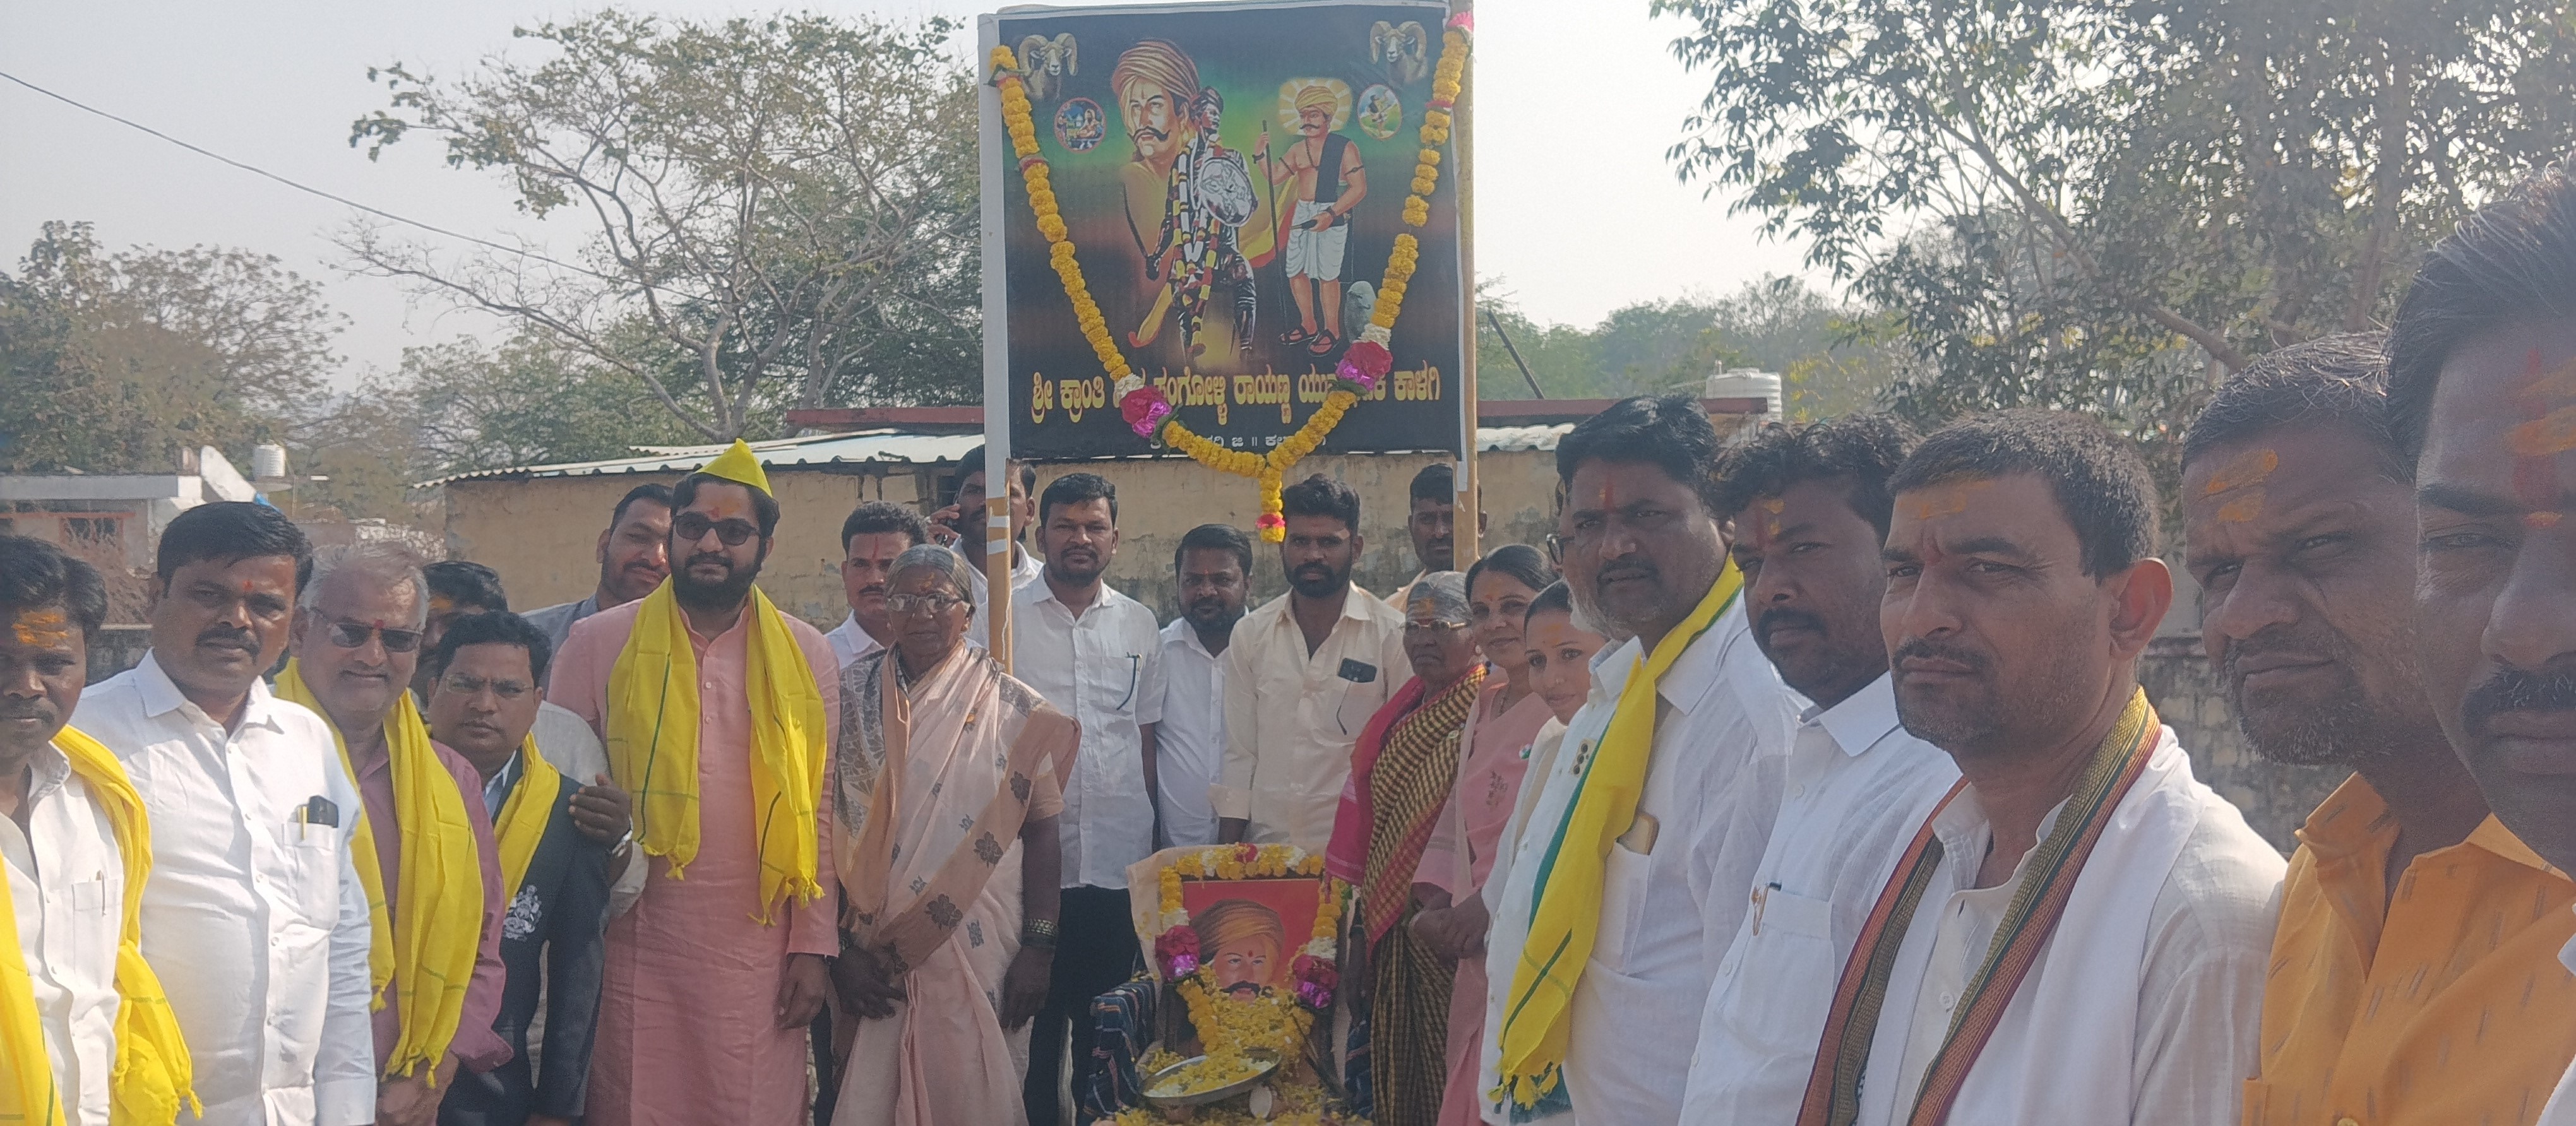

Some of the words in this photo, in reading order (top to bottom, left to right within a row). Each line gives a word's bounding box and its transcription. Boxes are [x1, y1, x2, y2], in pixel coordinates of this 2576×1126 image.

[1031, 372, 1053, 424] ಶ್ರೀ
[1059, 376, 1105, 423] ಕ್ರಾಂತಿ
[1233, 364, 1292, 424] ರಾಯಣ್ಣ
[1394, 360, 1440, 401] ಕಾಳಗಿ
